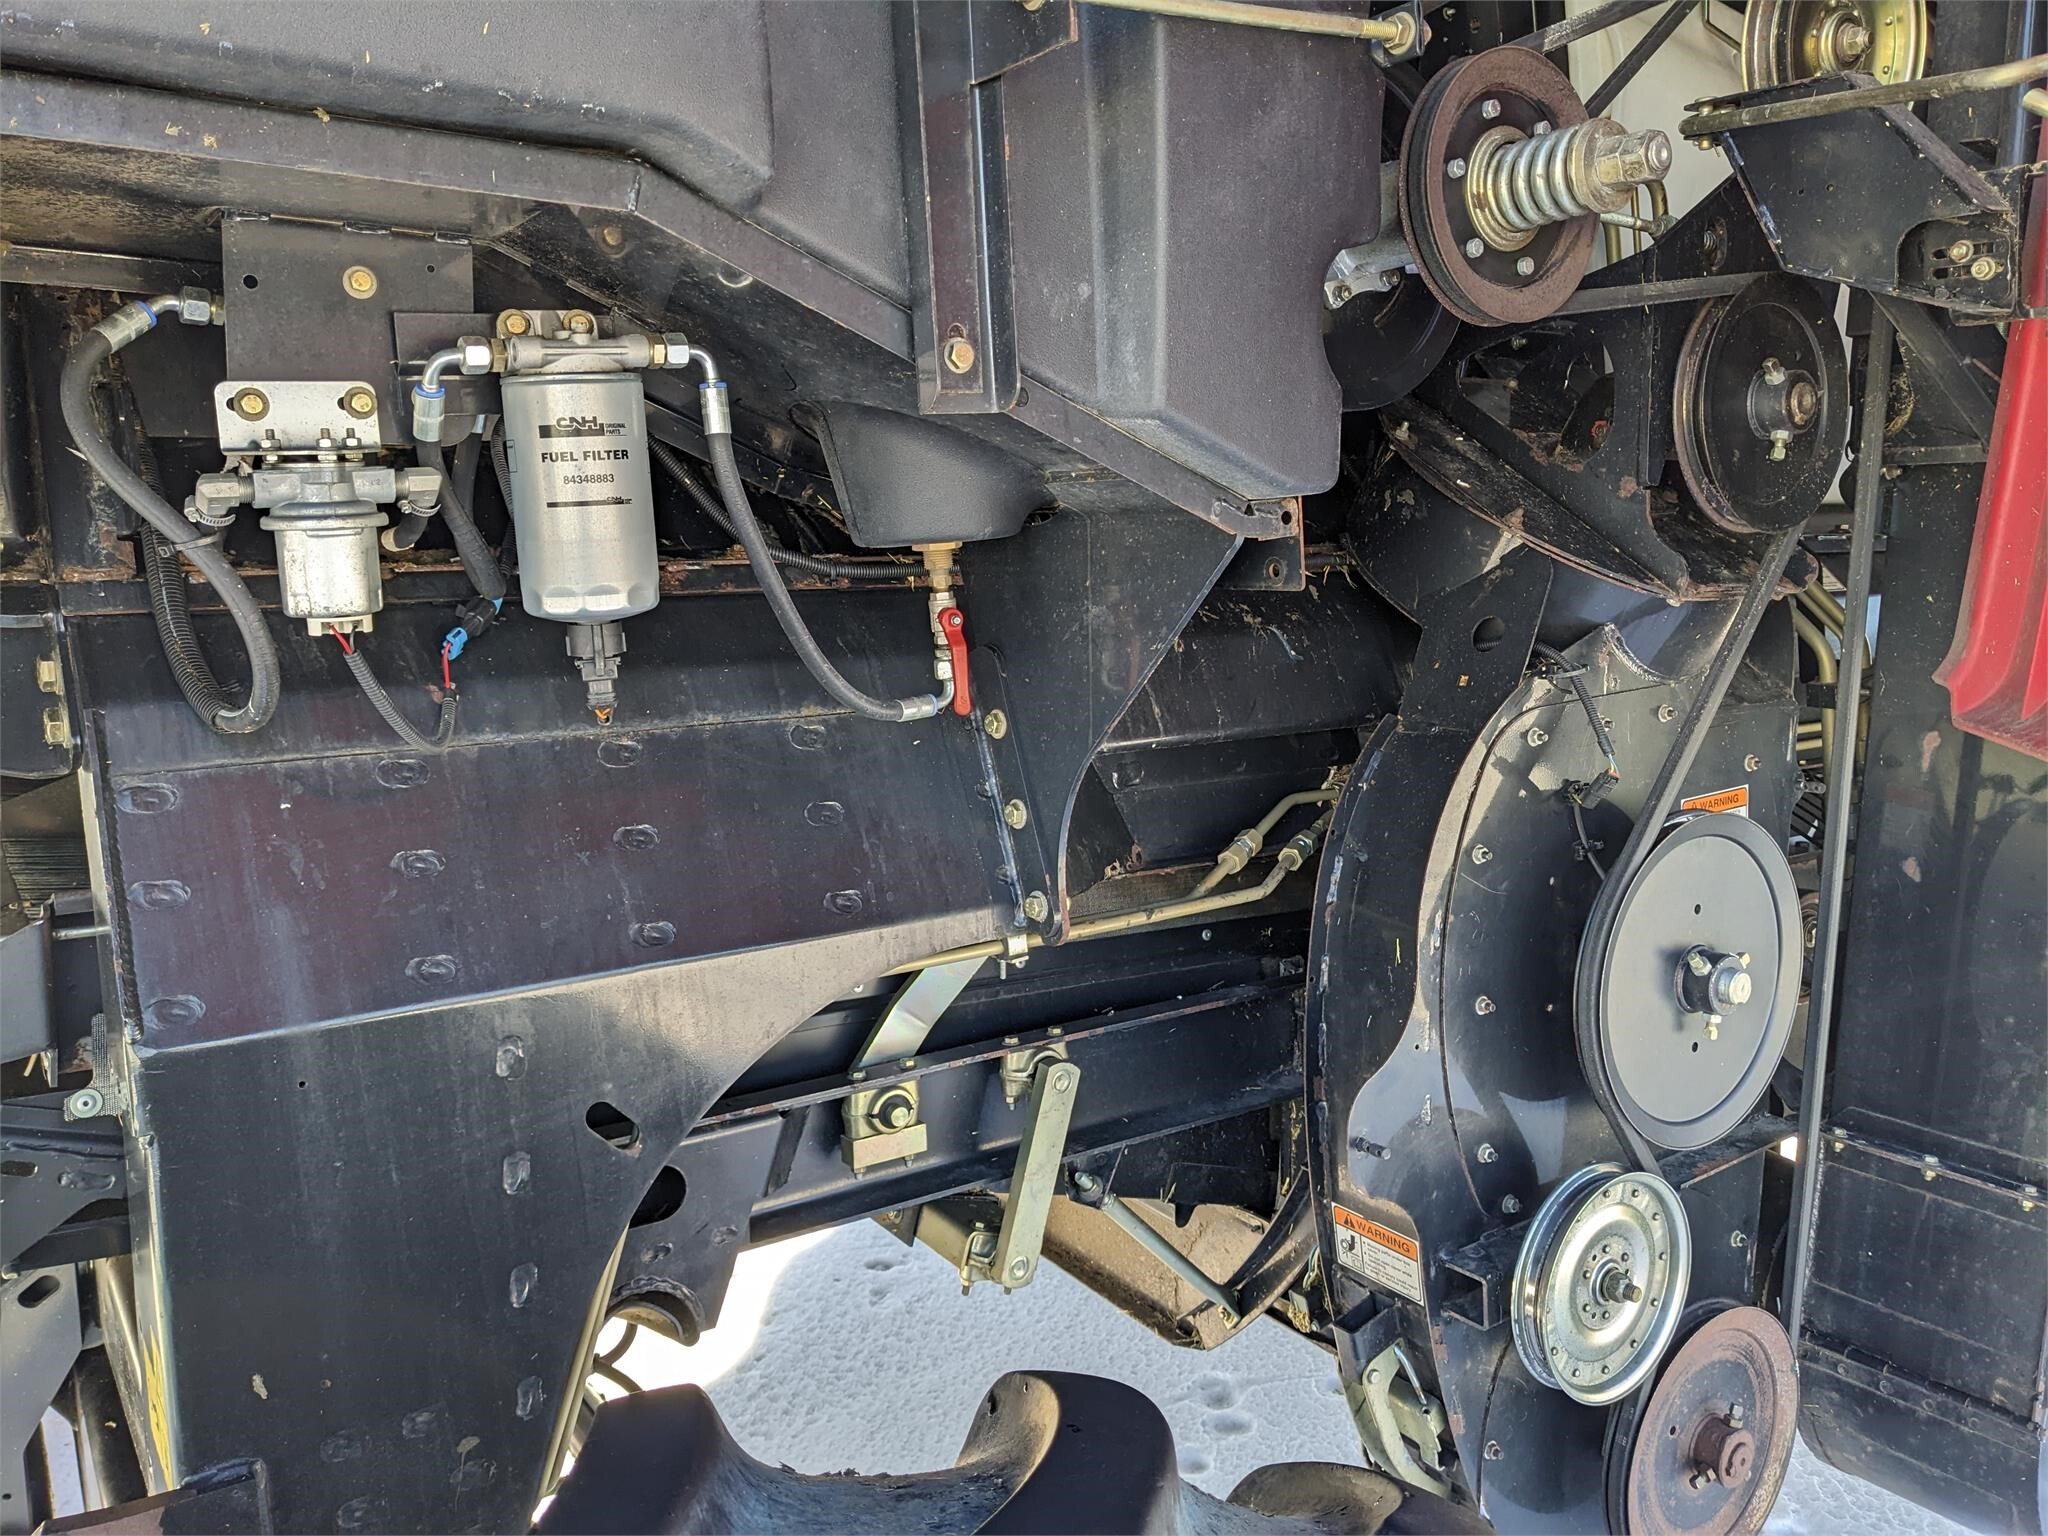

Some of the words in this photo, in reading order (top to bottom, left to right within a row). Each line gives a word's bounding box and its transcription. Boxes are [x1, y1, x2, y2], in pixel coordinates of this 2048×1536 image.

[556, 416, 598, 429] CNH
[541, 452, 578, 463] FUEL
[583, 449, 629, 461] FILTER
[563, 473, 615, 484] 84348883
[1700, 794, 1739, 810] WARNING
[1357, 1221, 1410, 1253] WARNING
